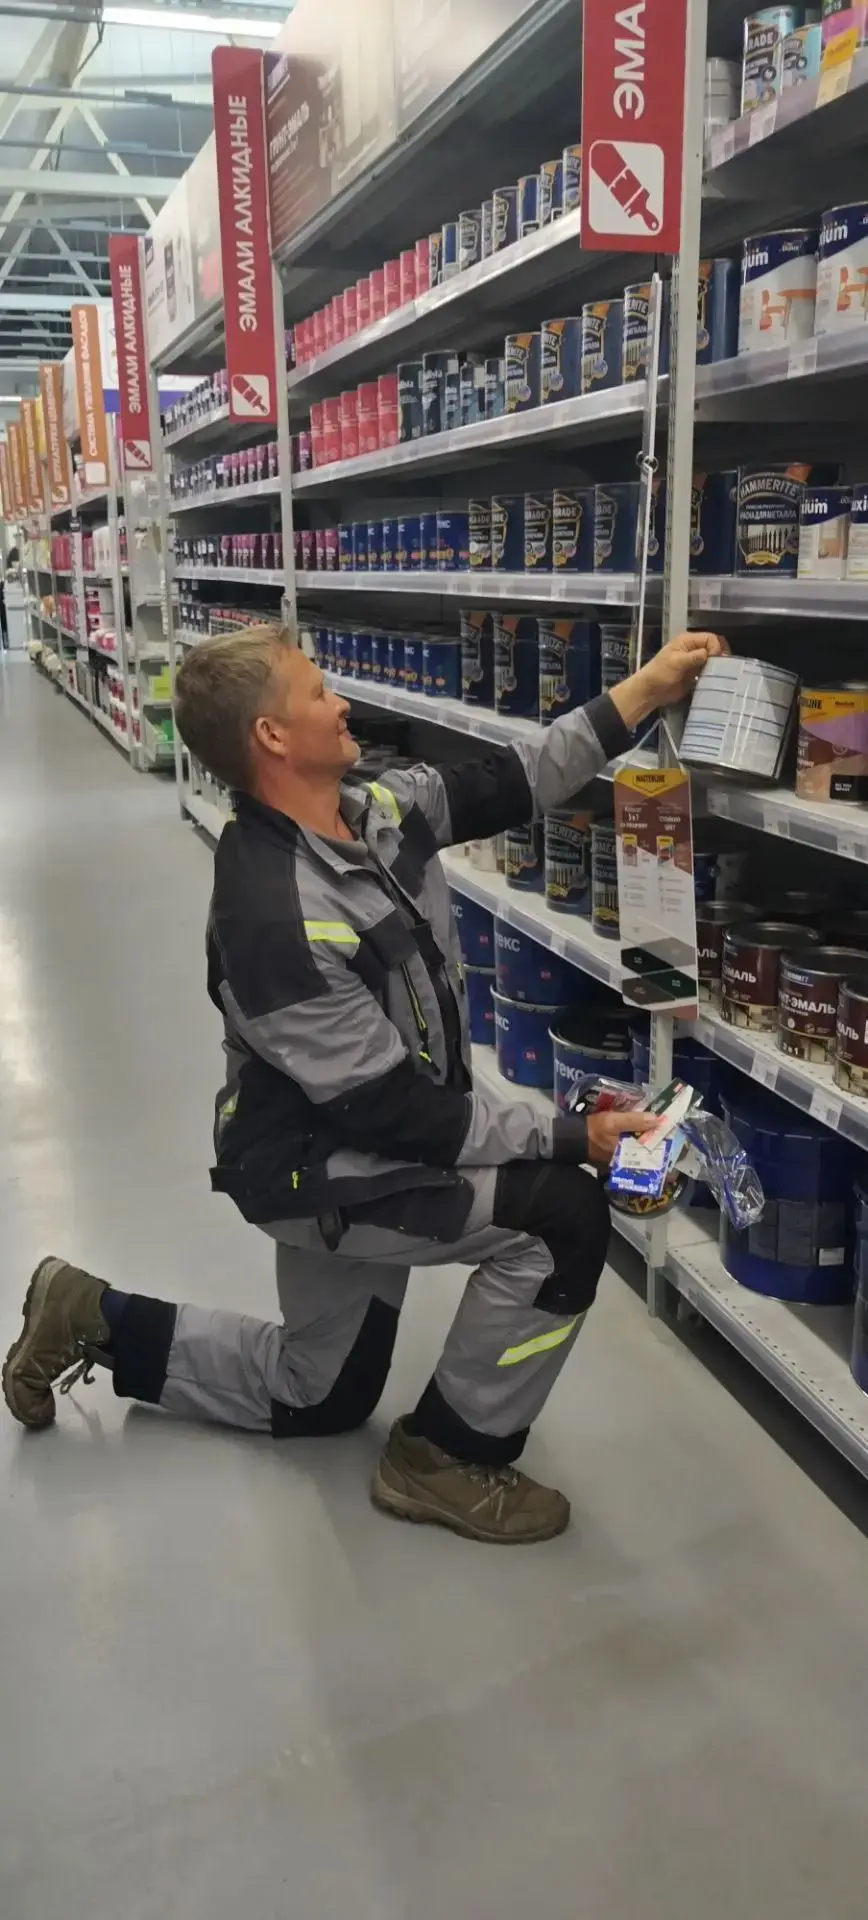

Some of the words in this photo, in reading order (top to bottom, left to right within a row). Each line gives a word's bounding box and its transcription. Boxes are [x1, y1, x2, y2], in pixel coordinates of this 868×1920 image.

[228, 94, 253, 235] АЛКИДНЫЕ
[119, 264, 138, 352] АЛКИДНЫЕ
[236, 240, 258, 332] ЭМАЛИ
[126, 355, 141, 414] ЭМАЛИ
[740, 478, 800, 498] HAMMERITE
